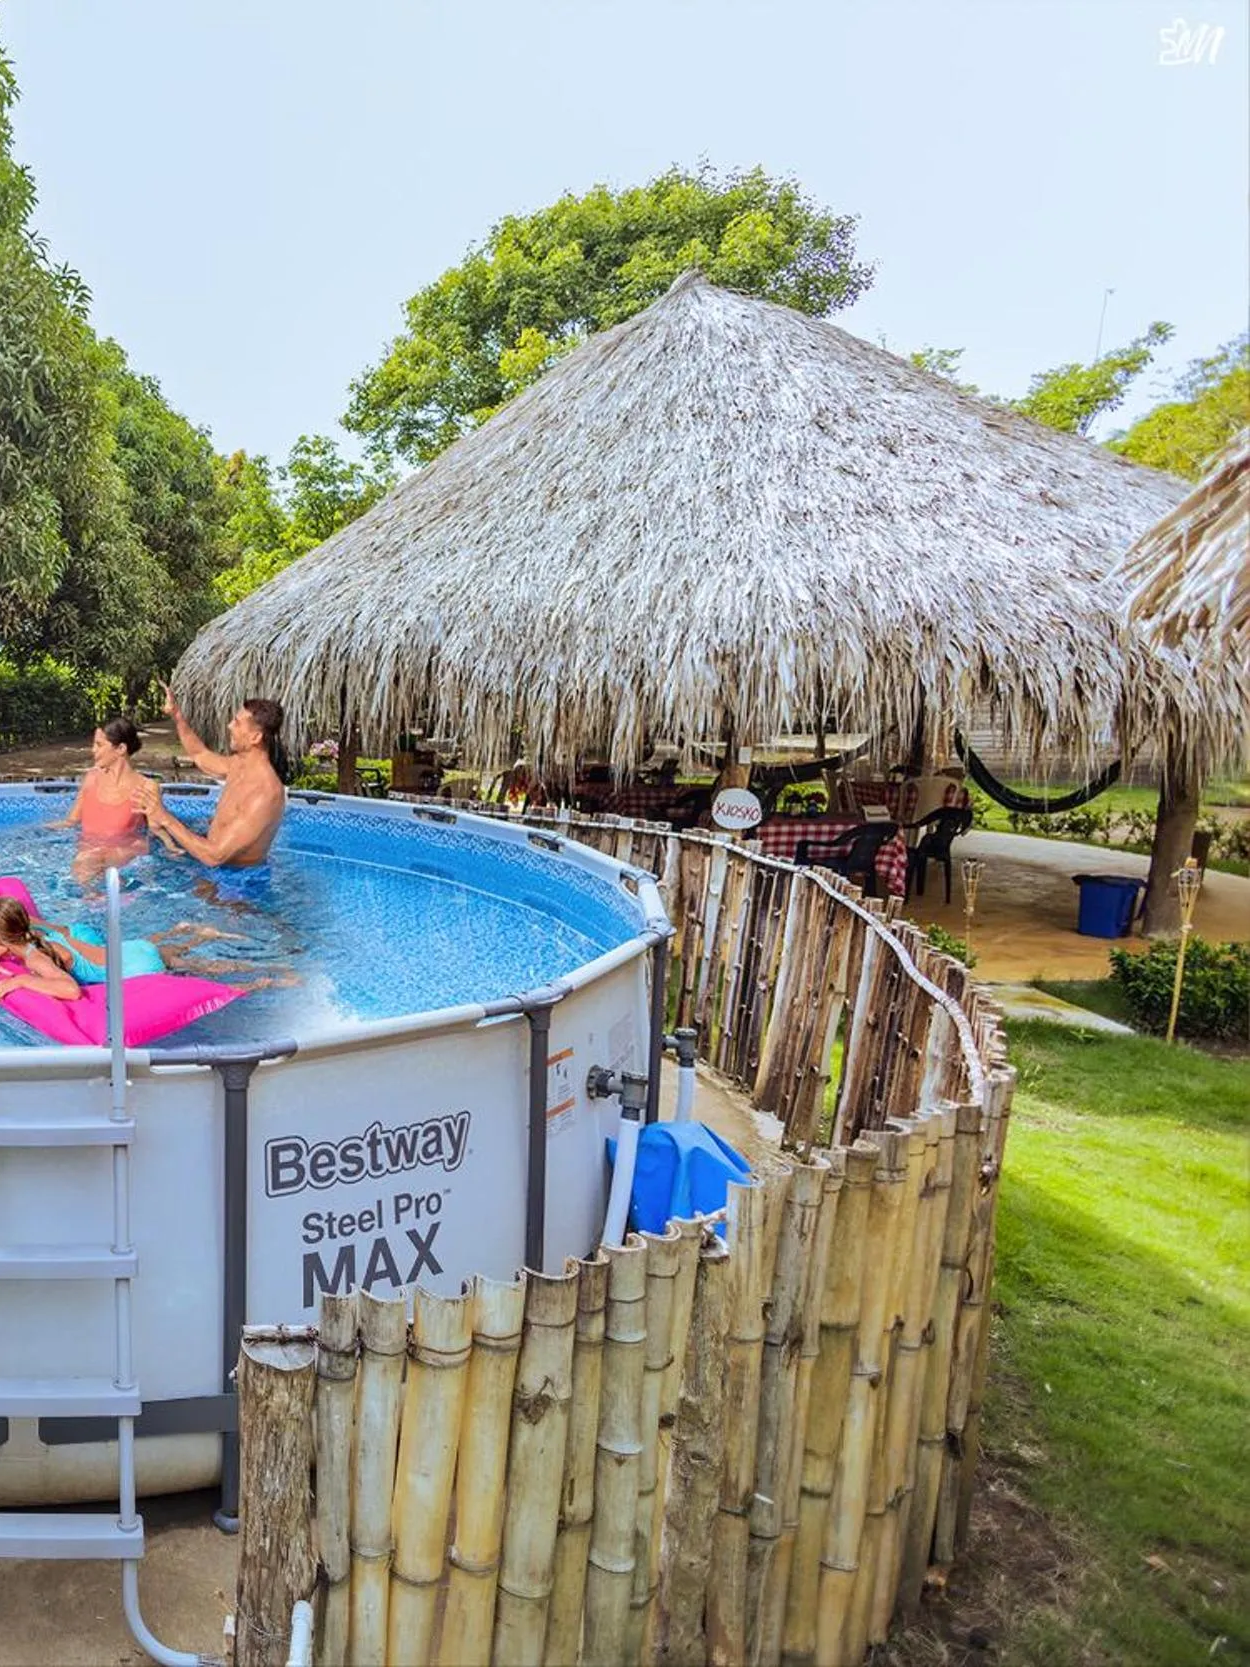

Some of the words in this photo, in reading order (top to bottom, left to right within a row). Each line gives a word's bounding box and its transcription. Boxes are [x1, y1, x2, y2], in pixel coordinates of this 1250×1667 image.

[266, 1112, 470, 1197] Bestway
[302, 1200, 383, 1244] Steel
[303, 1221, 444, 1308] MAX
